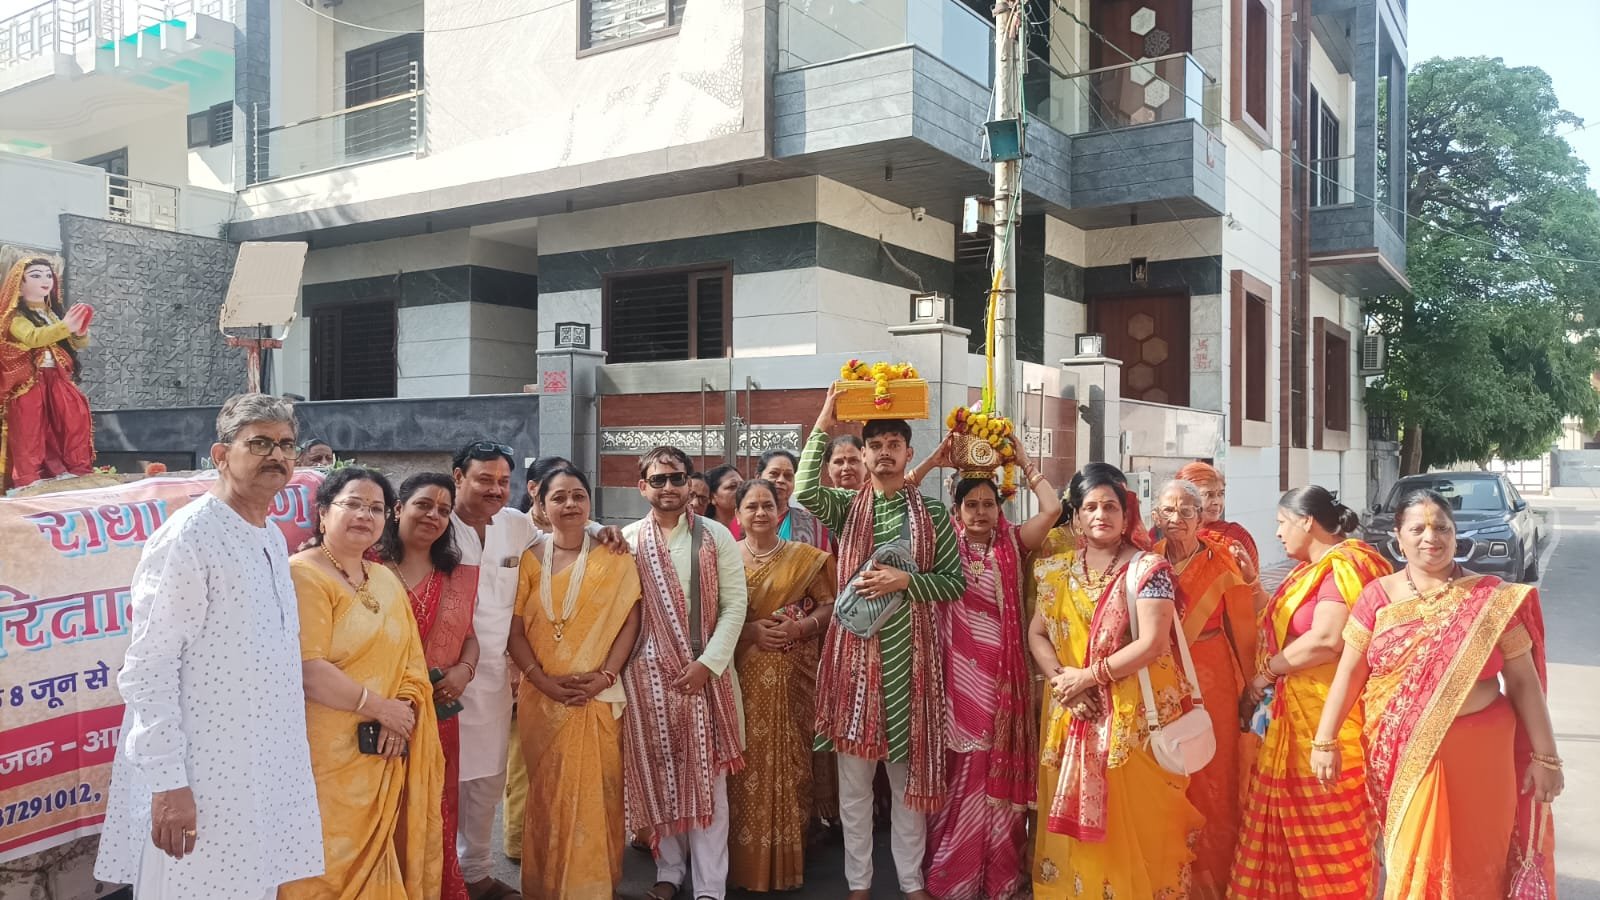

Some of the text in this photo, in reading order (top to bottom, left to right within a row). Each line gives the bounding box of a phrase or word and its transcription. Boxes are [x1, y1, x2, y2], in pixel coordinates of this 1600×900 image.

[10, 685, 24, 707] 8
[28, 672, 79, 709] जून
[83, 660, 110, 690] से
